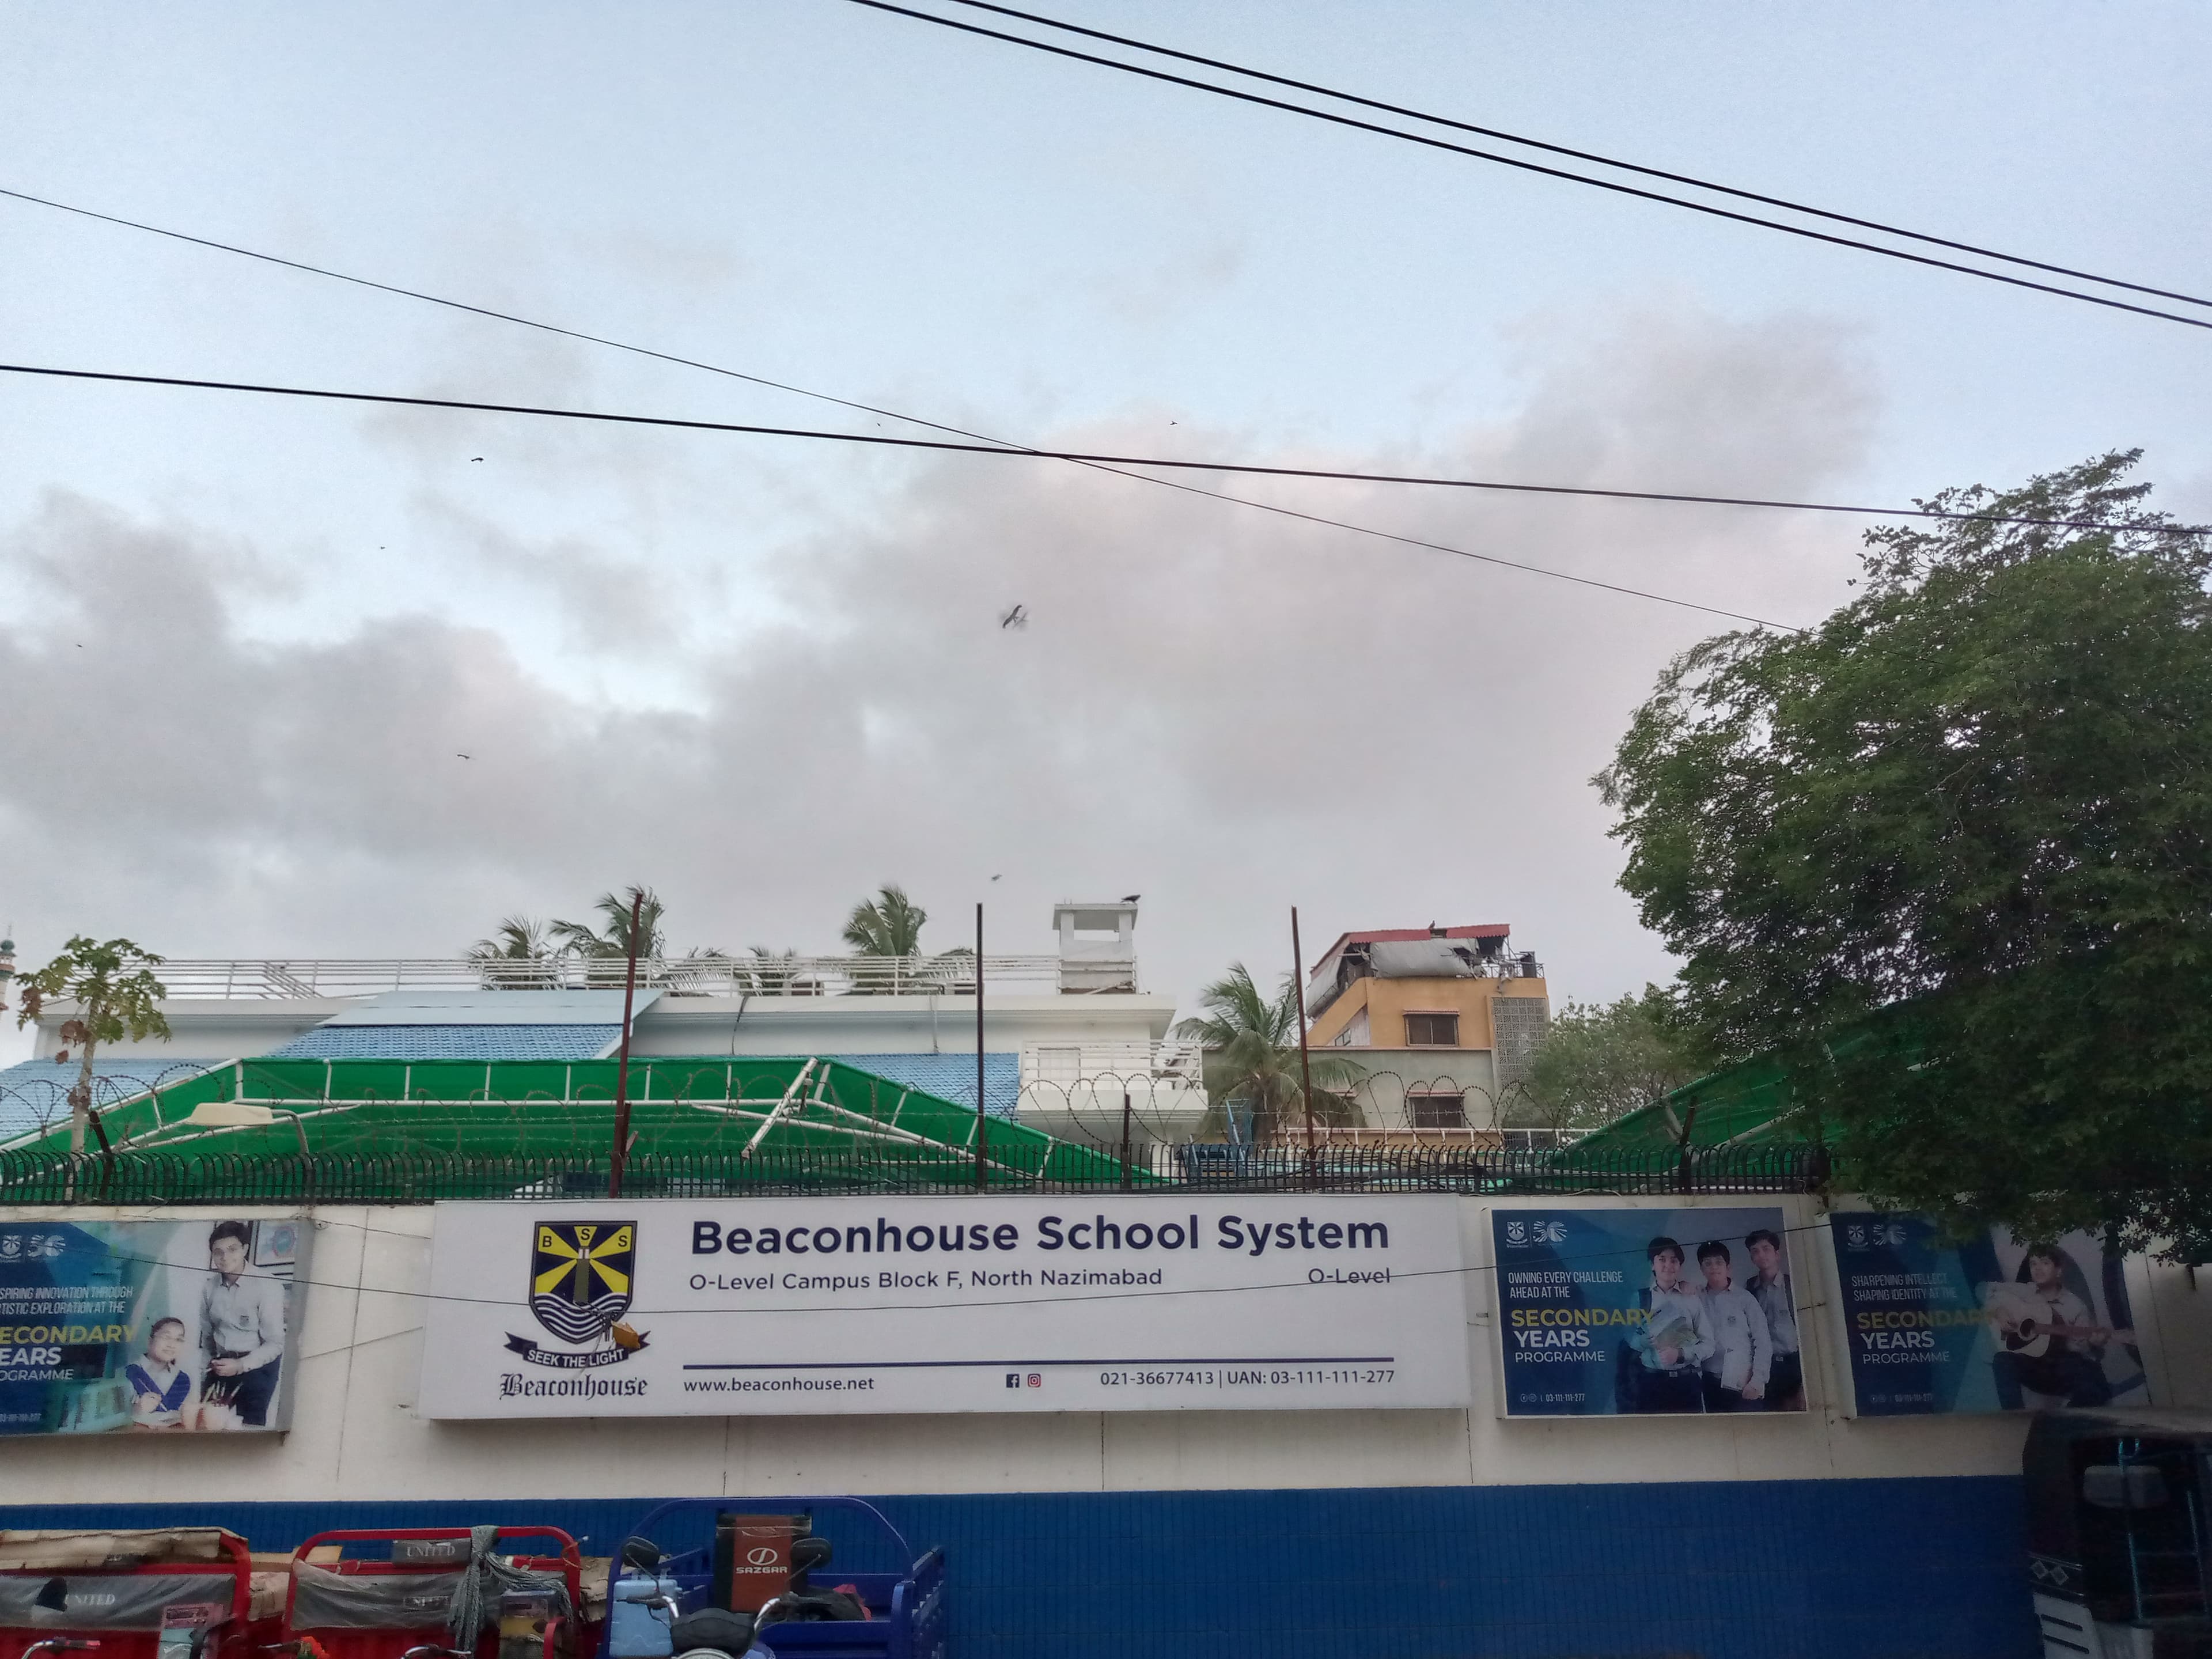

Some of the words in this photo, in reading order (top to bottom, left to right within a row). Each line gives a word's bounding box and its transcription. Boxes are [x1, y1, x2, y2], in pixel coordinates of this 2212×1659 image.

[543, 1236, 552, 1247] B
[581, 1228, 590, 1240] S
[618, 1235, 628, 1247] S
[692, 1217, 1018, 1255] Beaconhouse
[1037, 1214, 1198, 1250] School
[1218, 1215, 1388, 1256] System
[690, 1272, 774, 1290] O-Level
[782, 1273, 870, 1292] Campus
[879, 1271, 938, 1288] Block
[948, 1271, 962, 1290] F,
[972, 1270, 1032, 1286] North
[1041, 1268, 1161, 1285] Nazimabad
[1309, 1267, 1391, 1284] O-Level
[1508, 1272, 1542, 1284] OWNING
[1544, 1271, 1571, 1283] EVERY
[1573, 1271, 1623, 1283] CHALLENGE
[1851, 1275, 1904, 1287] SHARPENING
[36, 1286, 88, 1299] INNOVATION
[92, 1286, 133, 1298] THROUGH
[1510, 1287, 1539, 1298] AHEAD
[1541, 1286, 1552, 1297] AT
[1554, 1286, 1571, 1298] THE
[1853, 1289, 1889, 1301] SHAPING
[1891, 1288, 1926, 1300] IDENTITY
[30, 1301, 93, 1315] EXPLORATION
[94, 1301, 106, 1313] AT
[109, 1301, 126, 1313] THE
[1511, 1308, 1656, 1327] SECONDARY
[1513, 1329, 1590, 1348] YEARS
[1860, 1330, 1936, 1350] YEARS
[527, 1349, 559, 1367] SEEK
[562, 1355, 586, 1368] THE
[589, 1348, 625, 1366] LIGHT
[1515, 1350, 1605, 1363] PROGRAMME
[1862, 1351, 1950, 1365] PROGRAMME
[684, 1377, 874, 1392] www.beaconhouse.net
[1100, 1372, 1214, 1386] 021-36677413
[1228, 1371, 1266, 1384] UAN:
[1271, 1370, 1395, 1384] 03-111-111-277
[499, 1373, 648, 1400] Beaconhouse
[1546, 1393, 1585, 1402] 03-111-111-277
[407, 1546, 456, 1556] UNITD
